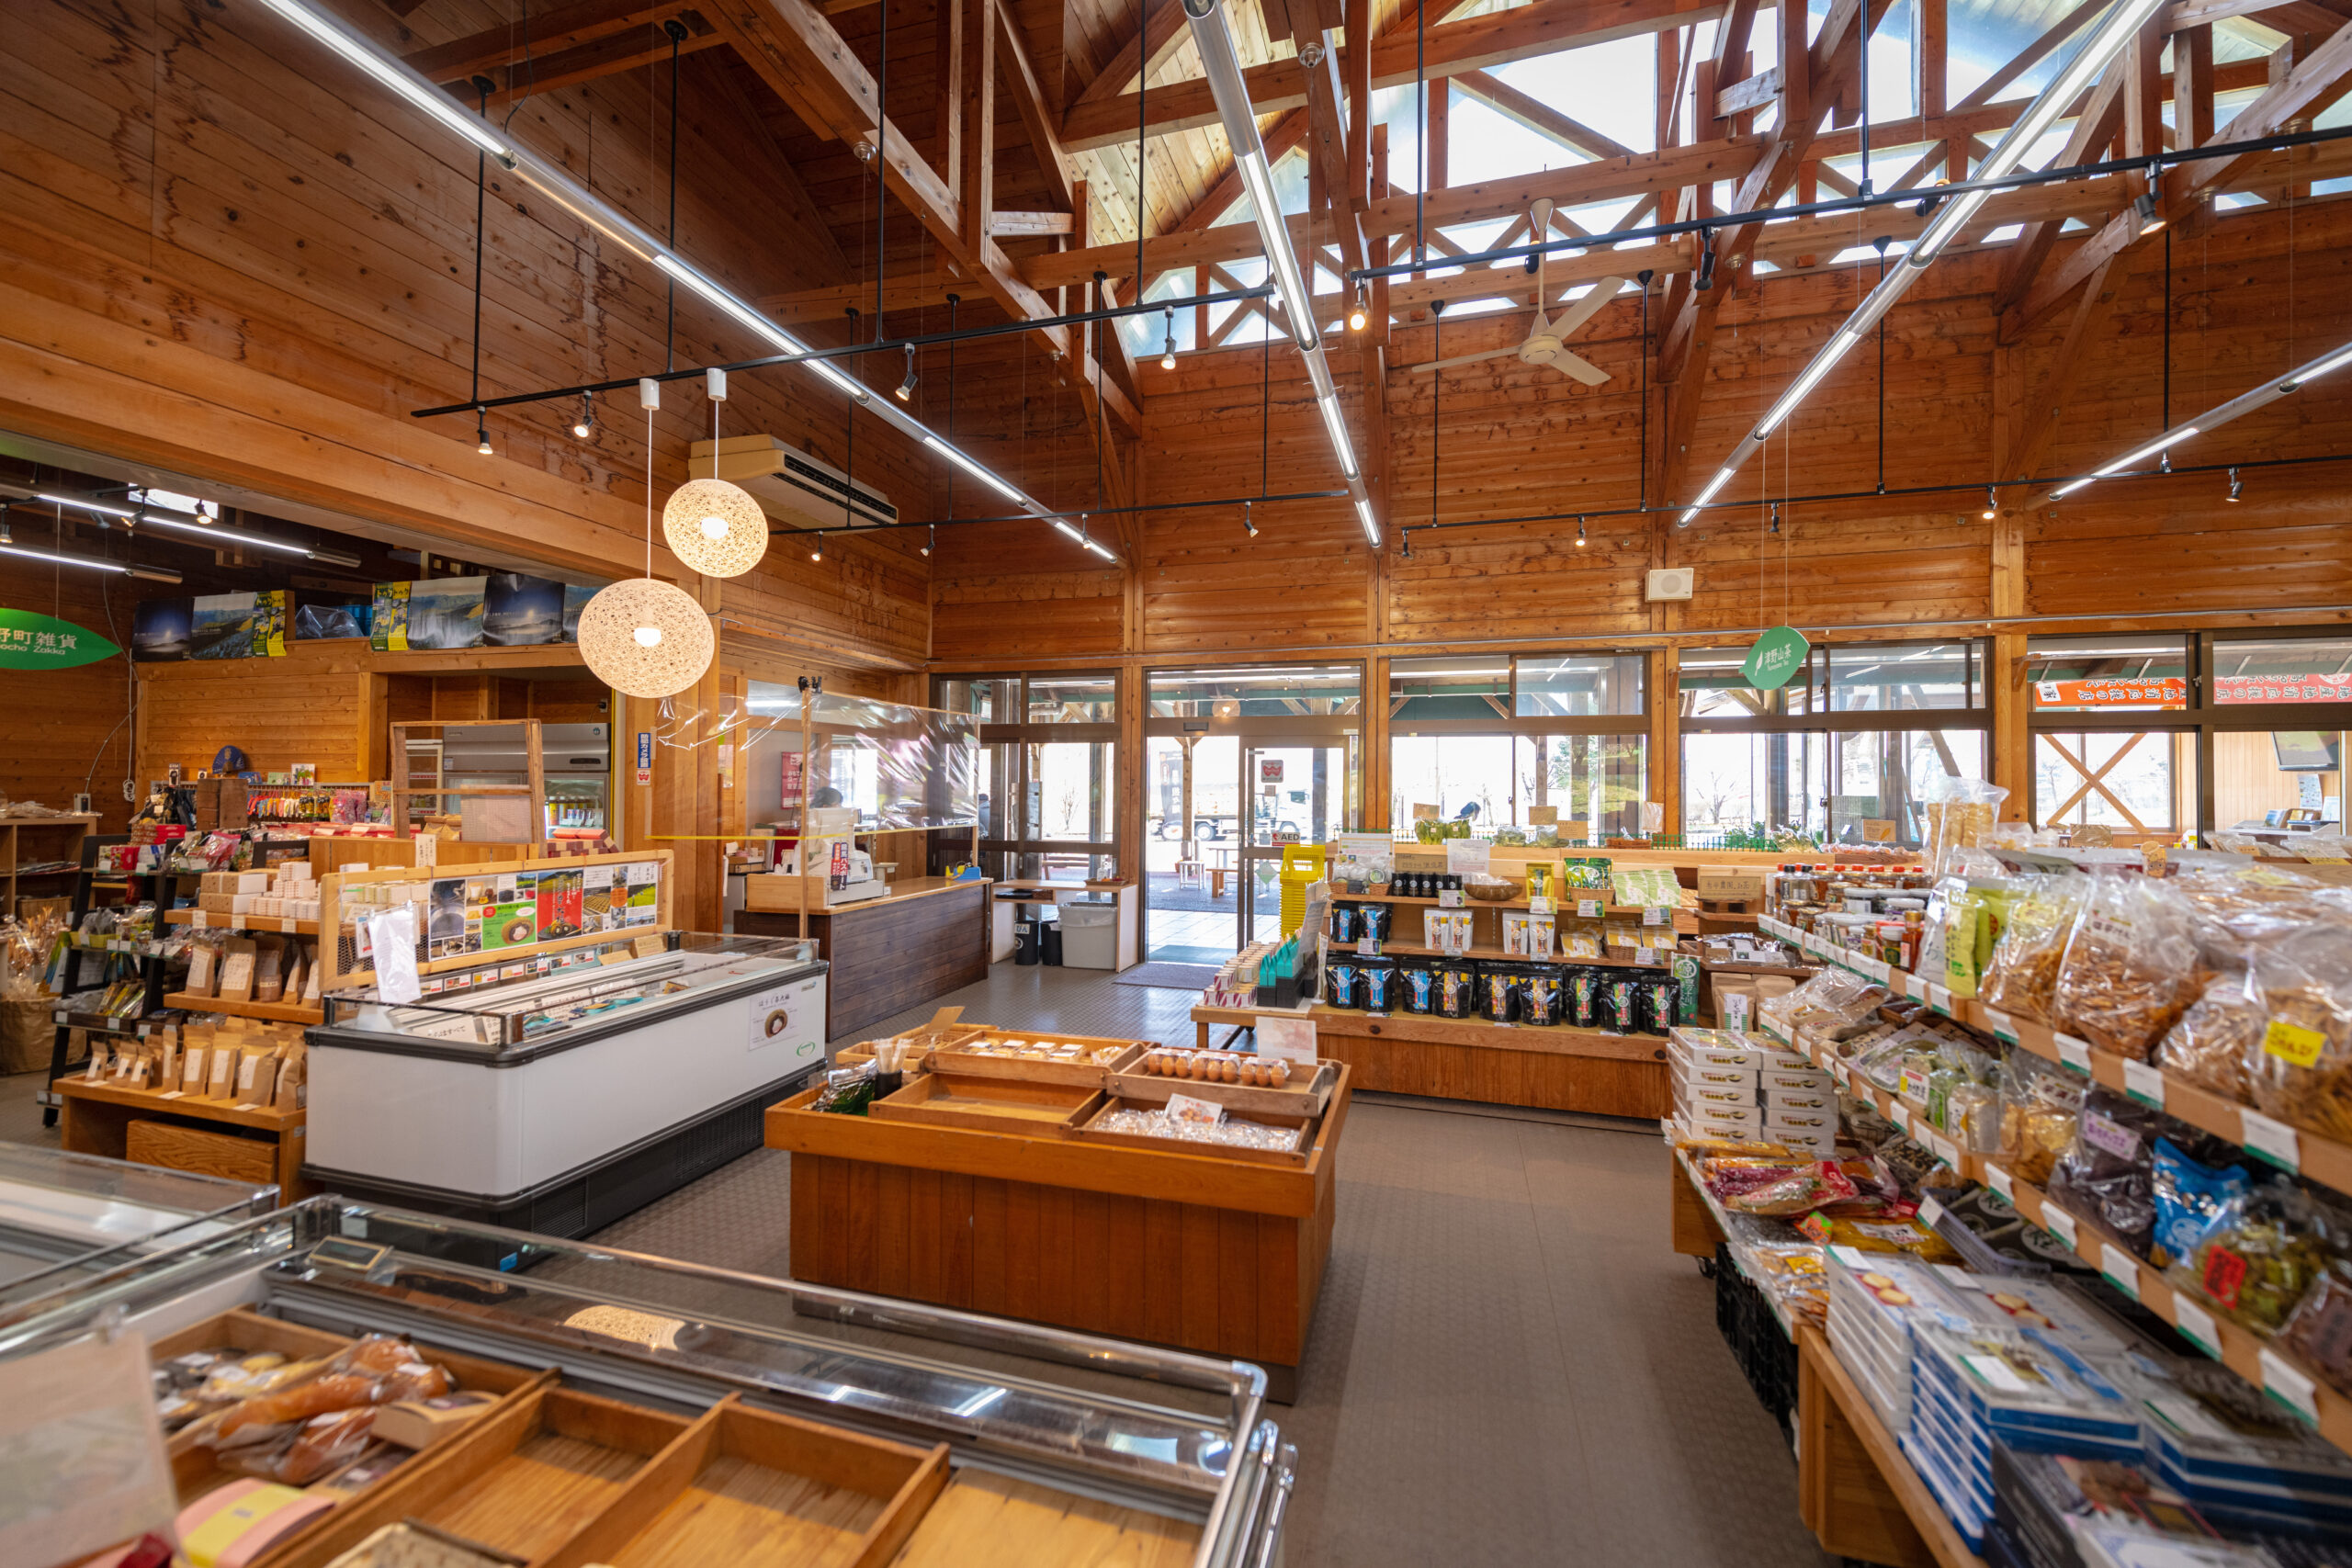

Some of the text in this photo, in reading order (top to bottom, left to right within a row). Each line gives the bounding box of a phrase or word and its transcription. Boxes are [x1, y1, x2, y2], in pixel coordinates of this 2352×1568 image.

[0, 643, 66, 655] ocho Zakka
[1765, 643, 1792, 665] 津野山茶
[1281, 833, 1300, 841] AED
